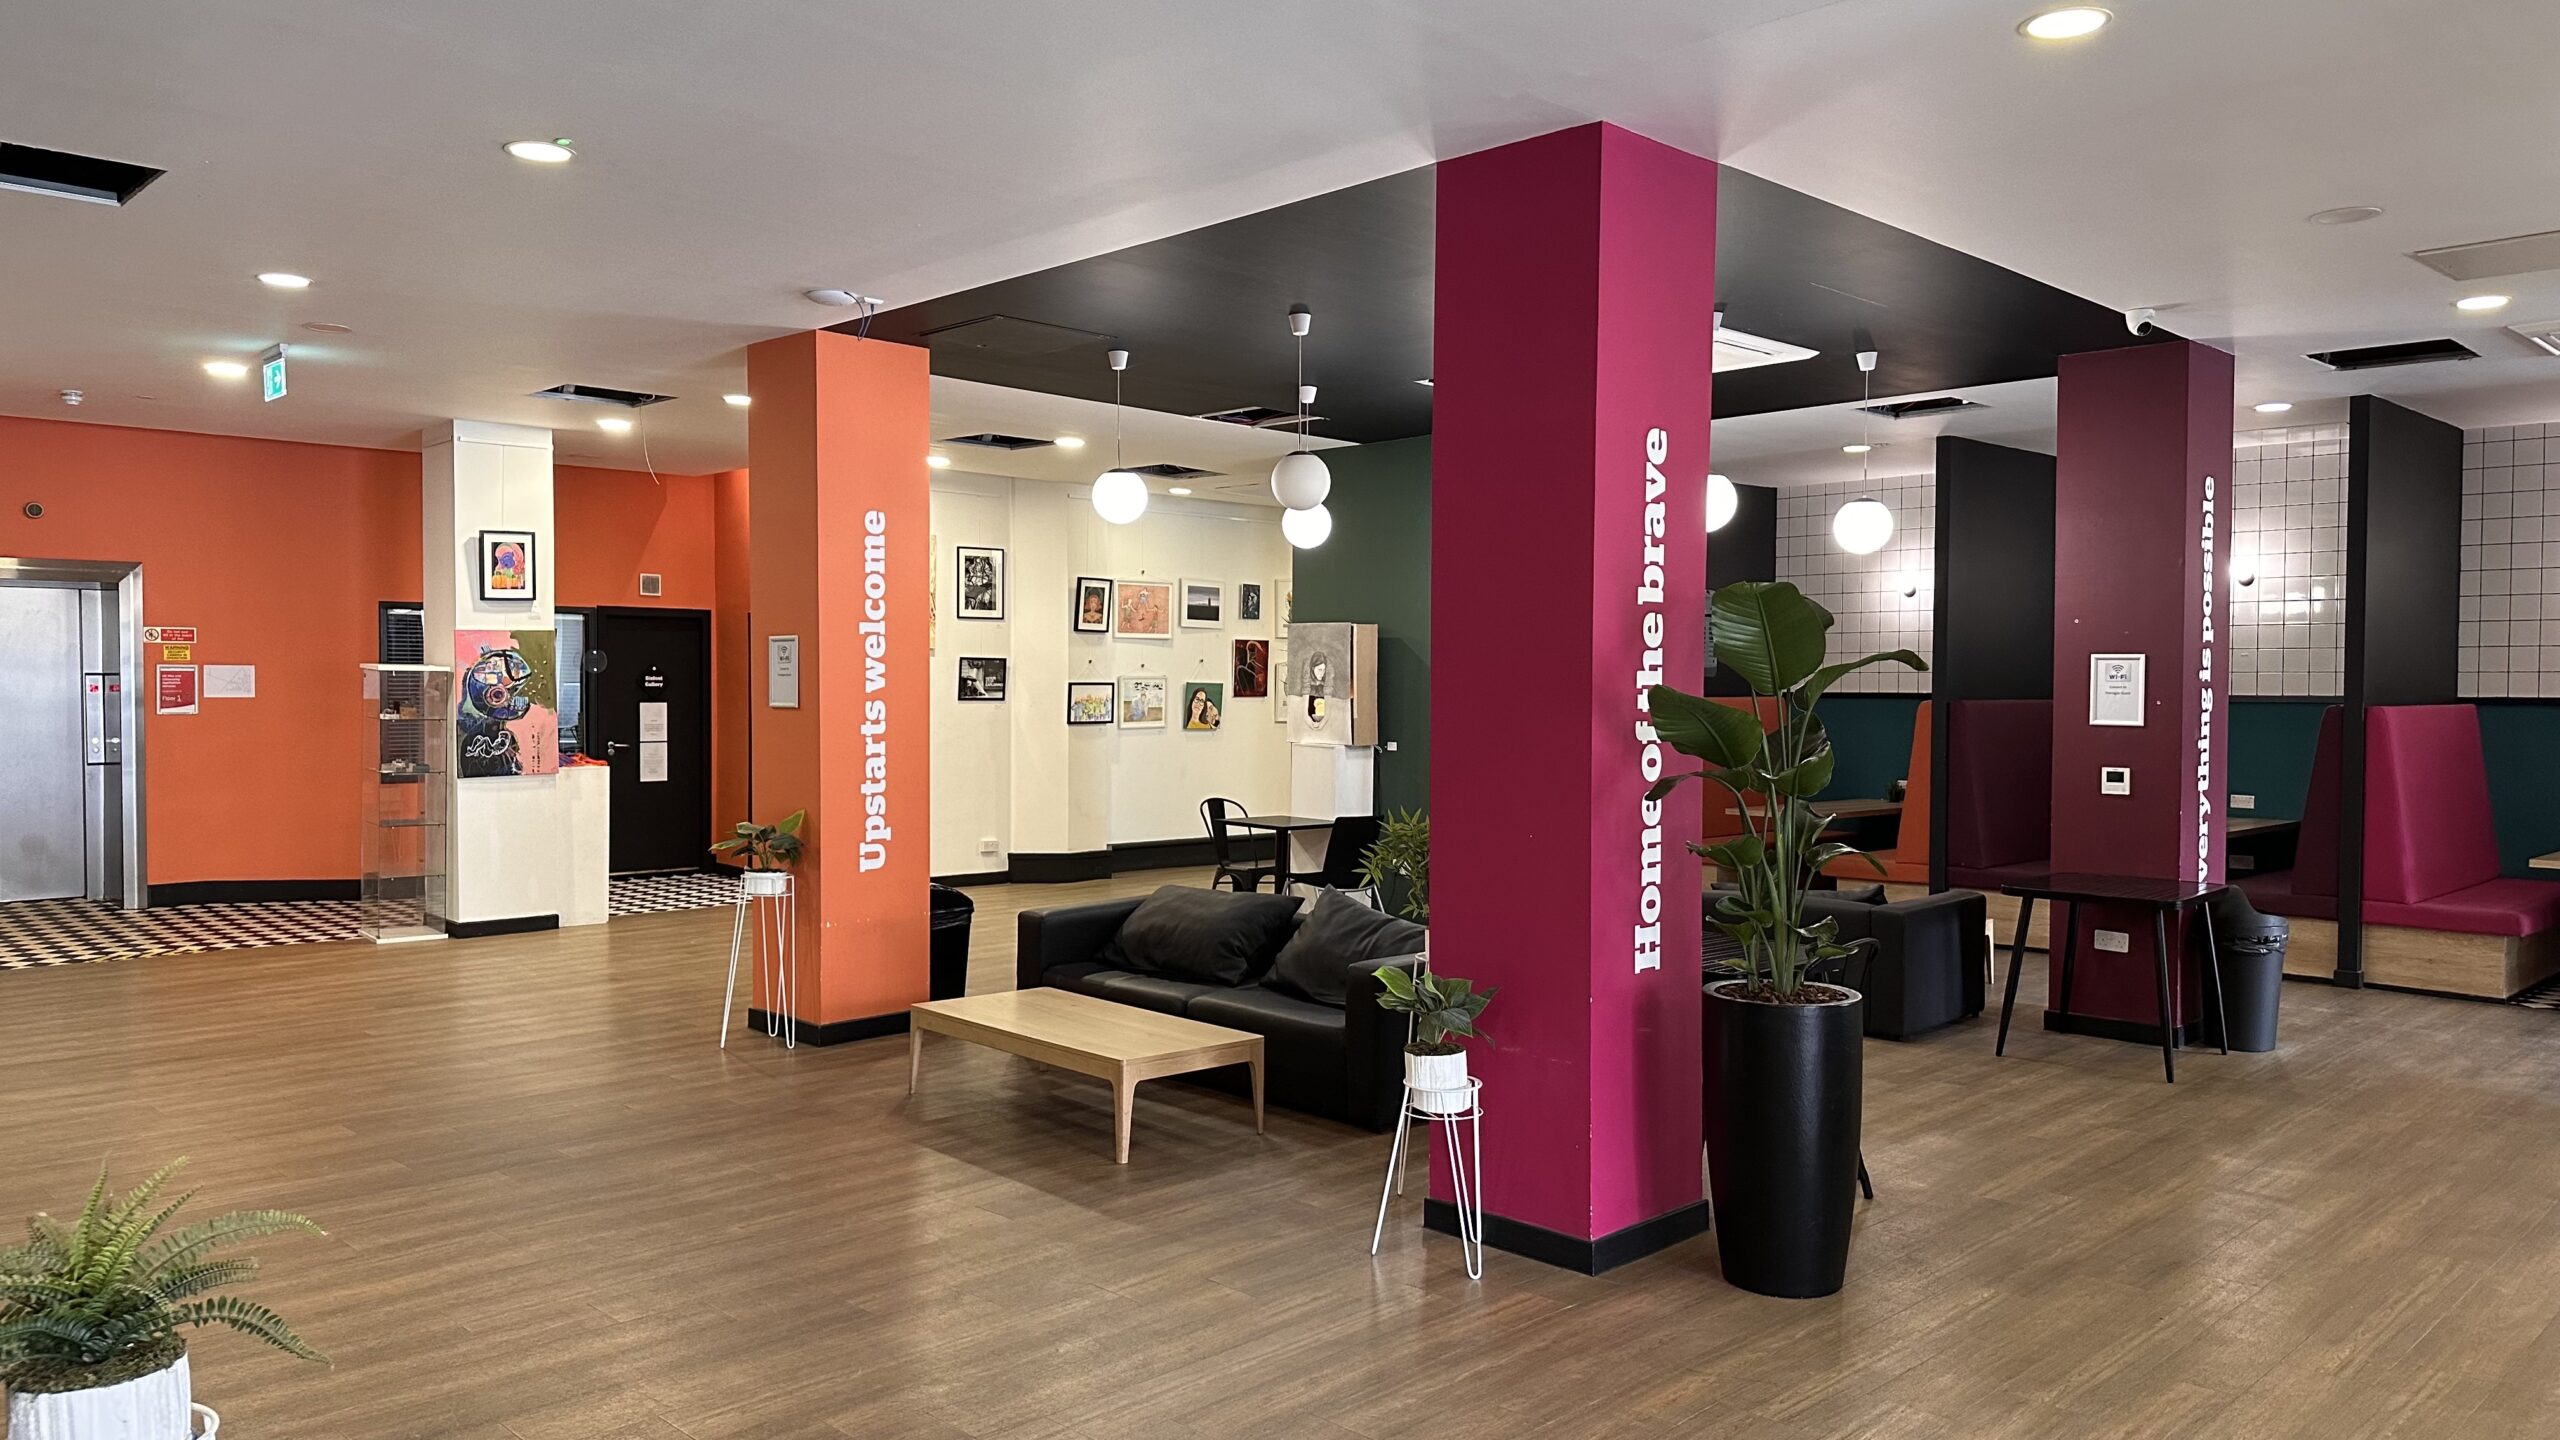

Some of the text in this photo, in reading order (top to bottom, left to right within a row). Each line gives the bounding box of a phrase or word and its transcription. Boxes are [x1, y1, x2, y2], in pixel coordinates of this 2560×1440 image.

[1637, 427, 1668, 606] brave
[859, 510, 892, 873] Upstarts welcome
[1635, 720, 1663, 783] of
[2197, 476, 2215, 883] verything is possible
[1634, 790, 1663, 975] Home
